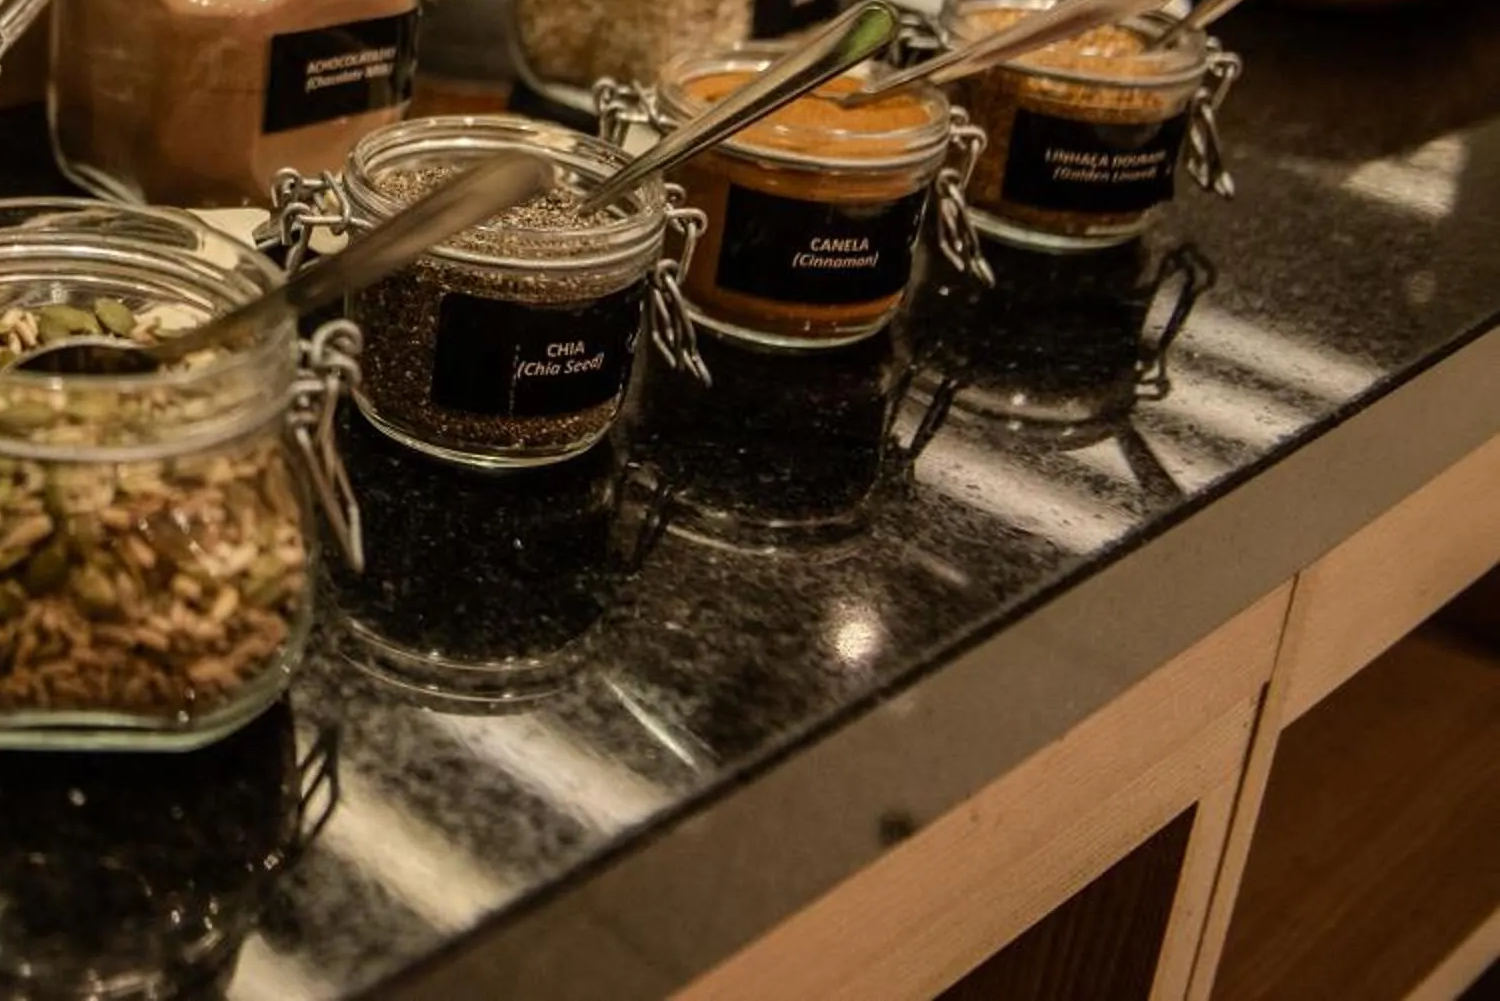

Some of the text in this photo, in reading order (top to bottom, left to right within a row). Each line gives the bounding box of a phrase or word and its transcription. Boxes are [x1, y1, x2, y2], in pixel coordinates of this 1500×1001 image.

[810, 237, 870, 253] CANELA
[792, 251, 879, 269] (Cinnamon)
[546, 340, 585, 358] CHIA
[517, 351, 605, 379] (Chia Seed)
